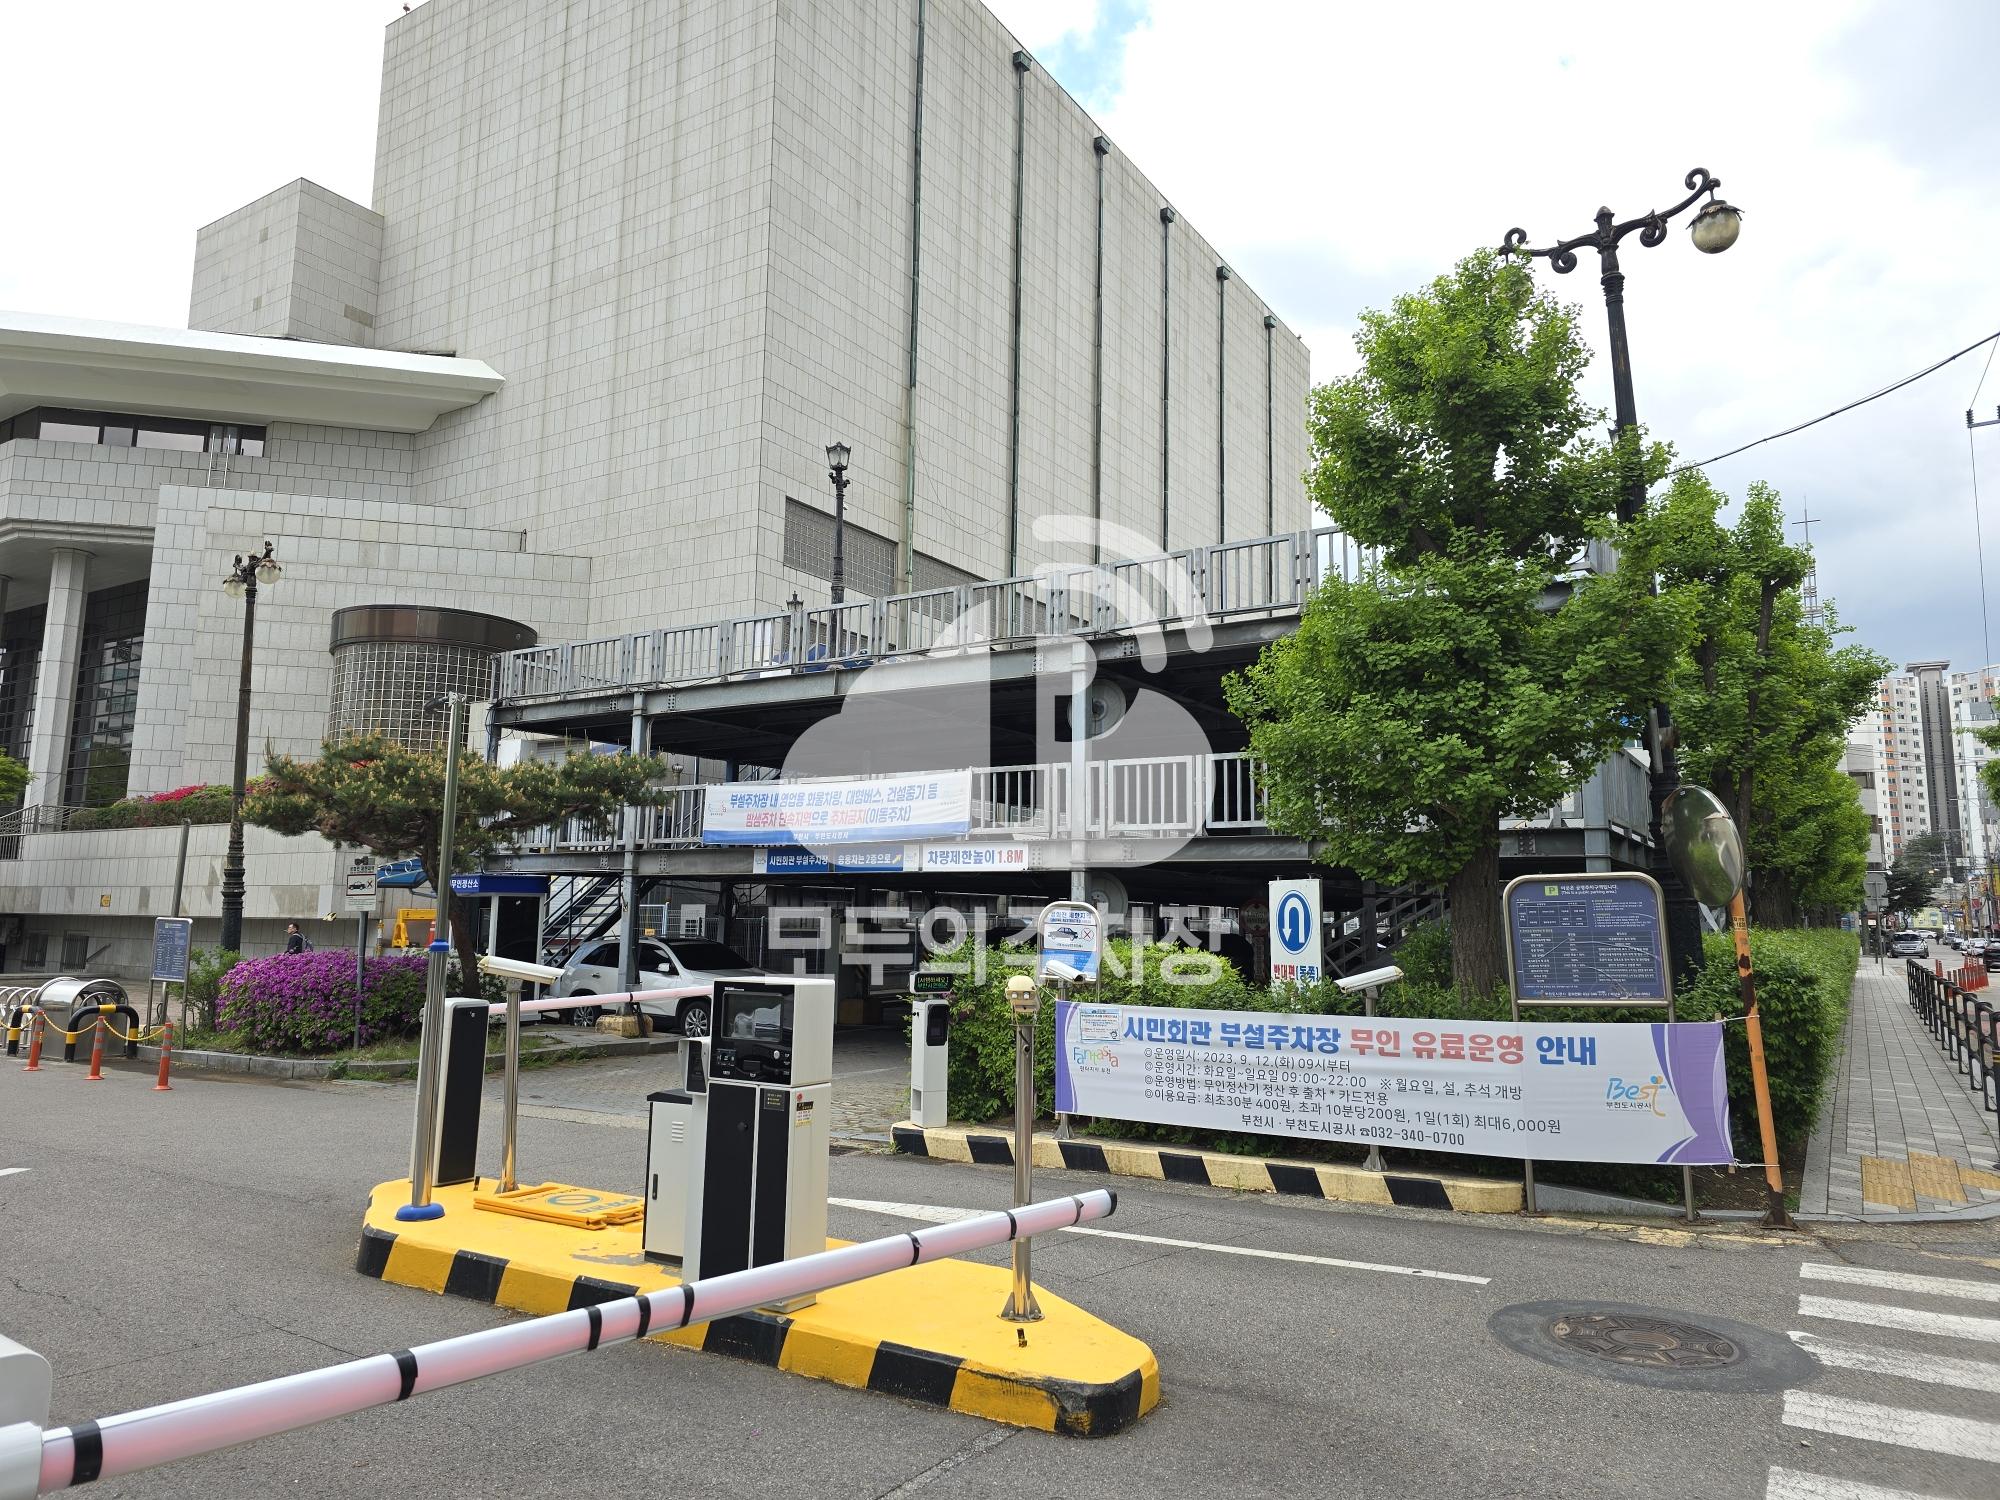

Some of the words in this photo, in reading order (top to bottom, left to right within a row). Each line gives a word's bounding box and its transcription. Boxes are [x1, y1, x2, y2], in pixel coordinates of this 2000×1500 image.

[730, 792, 769, 809] 부설주차장
[927, 849, 995, 866] 차량제한높이
[997, 849, 1024, 864] 1.8M
[1124, 1016, 1212, 1046] 시민회관
[1220, 1022, 1341, 1054] 부설주차장
[1350, 1029, 1400, 1057] 무인
[1412, 1031, 1524, 1065] 유료운영
[1536, 1036, 1597, 1065] 안내
[1073, 1045, 1119, 1068] Fantasia
[1154, 1047, 1200, 1063] 운영일시:
[1203, 1052, 1237, 1065] 2023.
[1240, 1054, 1251, 1066] 9.
[1298, 1058, 1351, 1074] 09시부터
[1154, 1061, 1200, 1076] 운영시간:
[1204, 1065, 1278, 1083] 화요일~일요일
[1281, 1071, 1367, 1088] 09:00~22:00
[1395, 1078, 1438, 1096] 월요일,
[1442, 1081, 1460, 1097] 설,
[1464, 1083, 1491, 1099] 추석
[1495, 1084, 1523, 1101] 개방
[1154, 1075, 1200, 1091] 운영방법:
[1203, 1079, 1259, 1096] 무인정산기
[1263, 1084, 1285, 1098] 정산
[1288, 1086, 1299, 1099] 후
[1303, 1087, 1327, 1101] 출차
[1339, 1089, 1389, 1106] 카드전용
[1606, 1075, 1667, 1117] Best
[1154, 1088, 1200, 1105] 이용요금:
[1204, 1093, 1253, 1110] 최초30분
[1256, 1098, 1295, 1114] 400원,
[1298, 1101, 1322, 1115] 초과
[1326, 1104, 1410, 1124] 10분당200원,
[1415, 1111, 1470, 1128] 1일(1회)
[1474, 1115, 1561, 1134] 최대6,000원
[1606, 1101, 1652, 1110] 부천도시공사
[1241, 1114, 1274, 1128] 부천시
[1285, 1118, 1355, 1136] 부천도시공사
[1370, 1126, 1465, 1146] 032-340-0700
